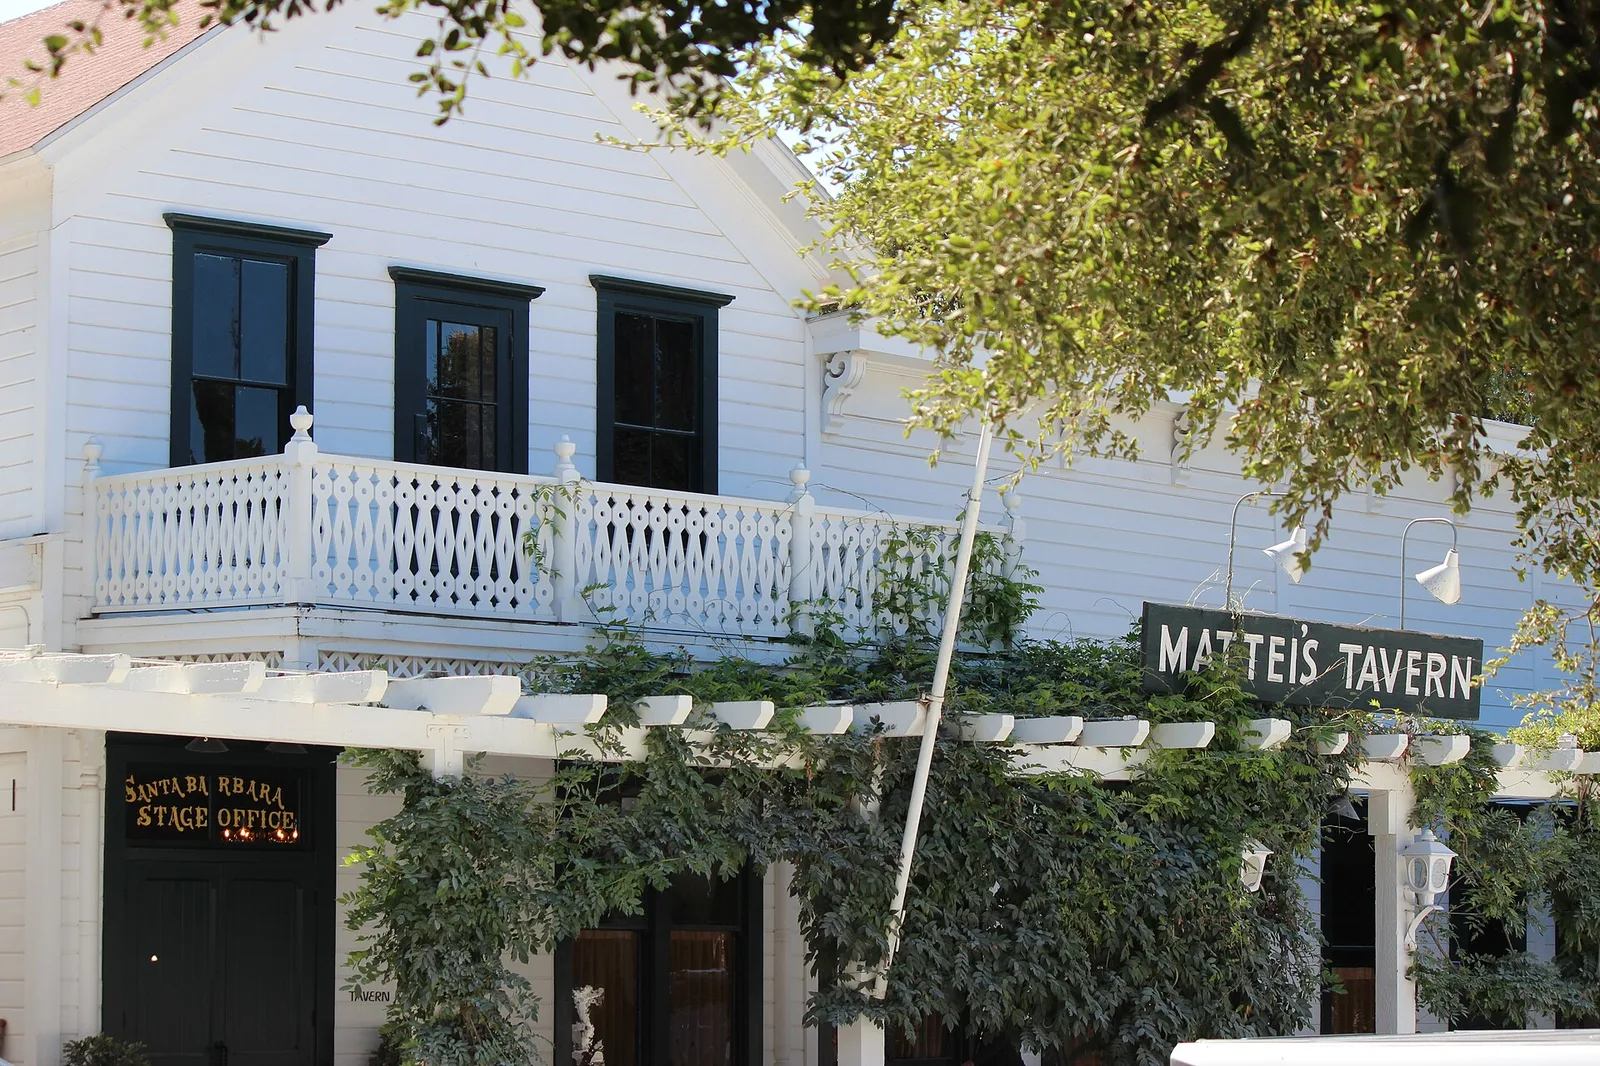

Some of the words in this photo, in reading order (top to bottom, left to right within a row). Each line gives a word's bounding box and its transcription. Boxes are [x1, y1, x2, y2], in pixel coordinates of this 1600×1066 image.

[1158, 623, 1319, 686] MATTEI'S
[1338, 643, 1473, 700] TAVERN
[125, 775, 186, 803] SANTA
[136, 805, 209, 832] STAGE
[217, 808, 294, 830] OFFICE
